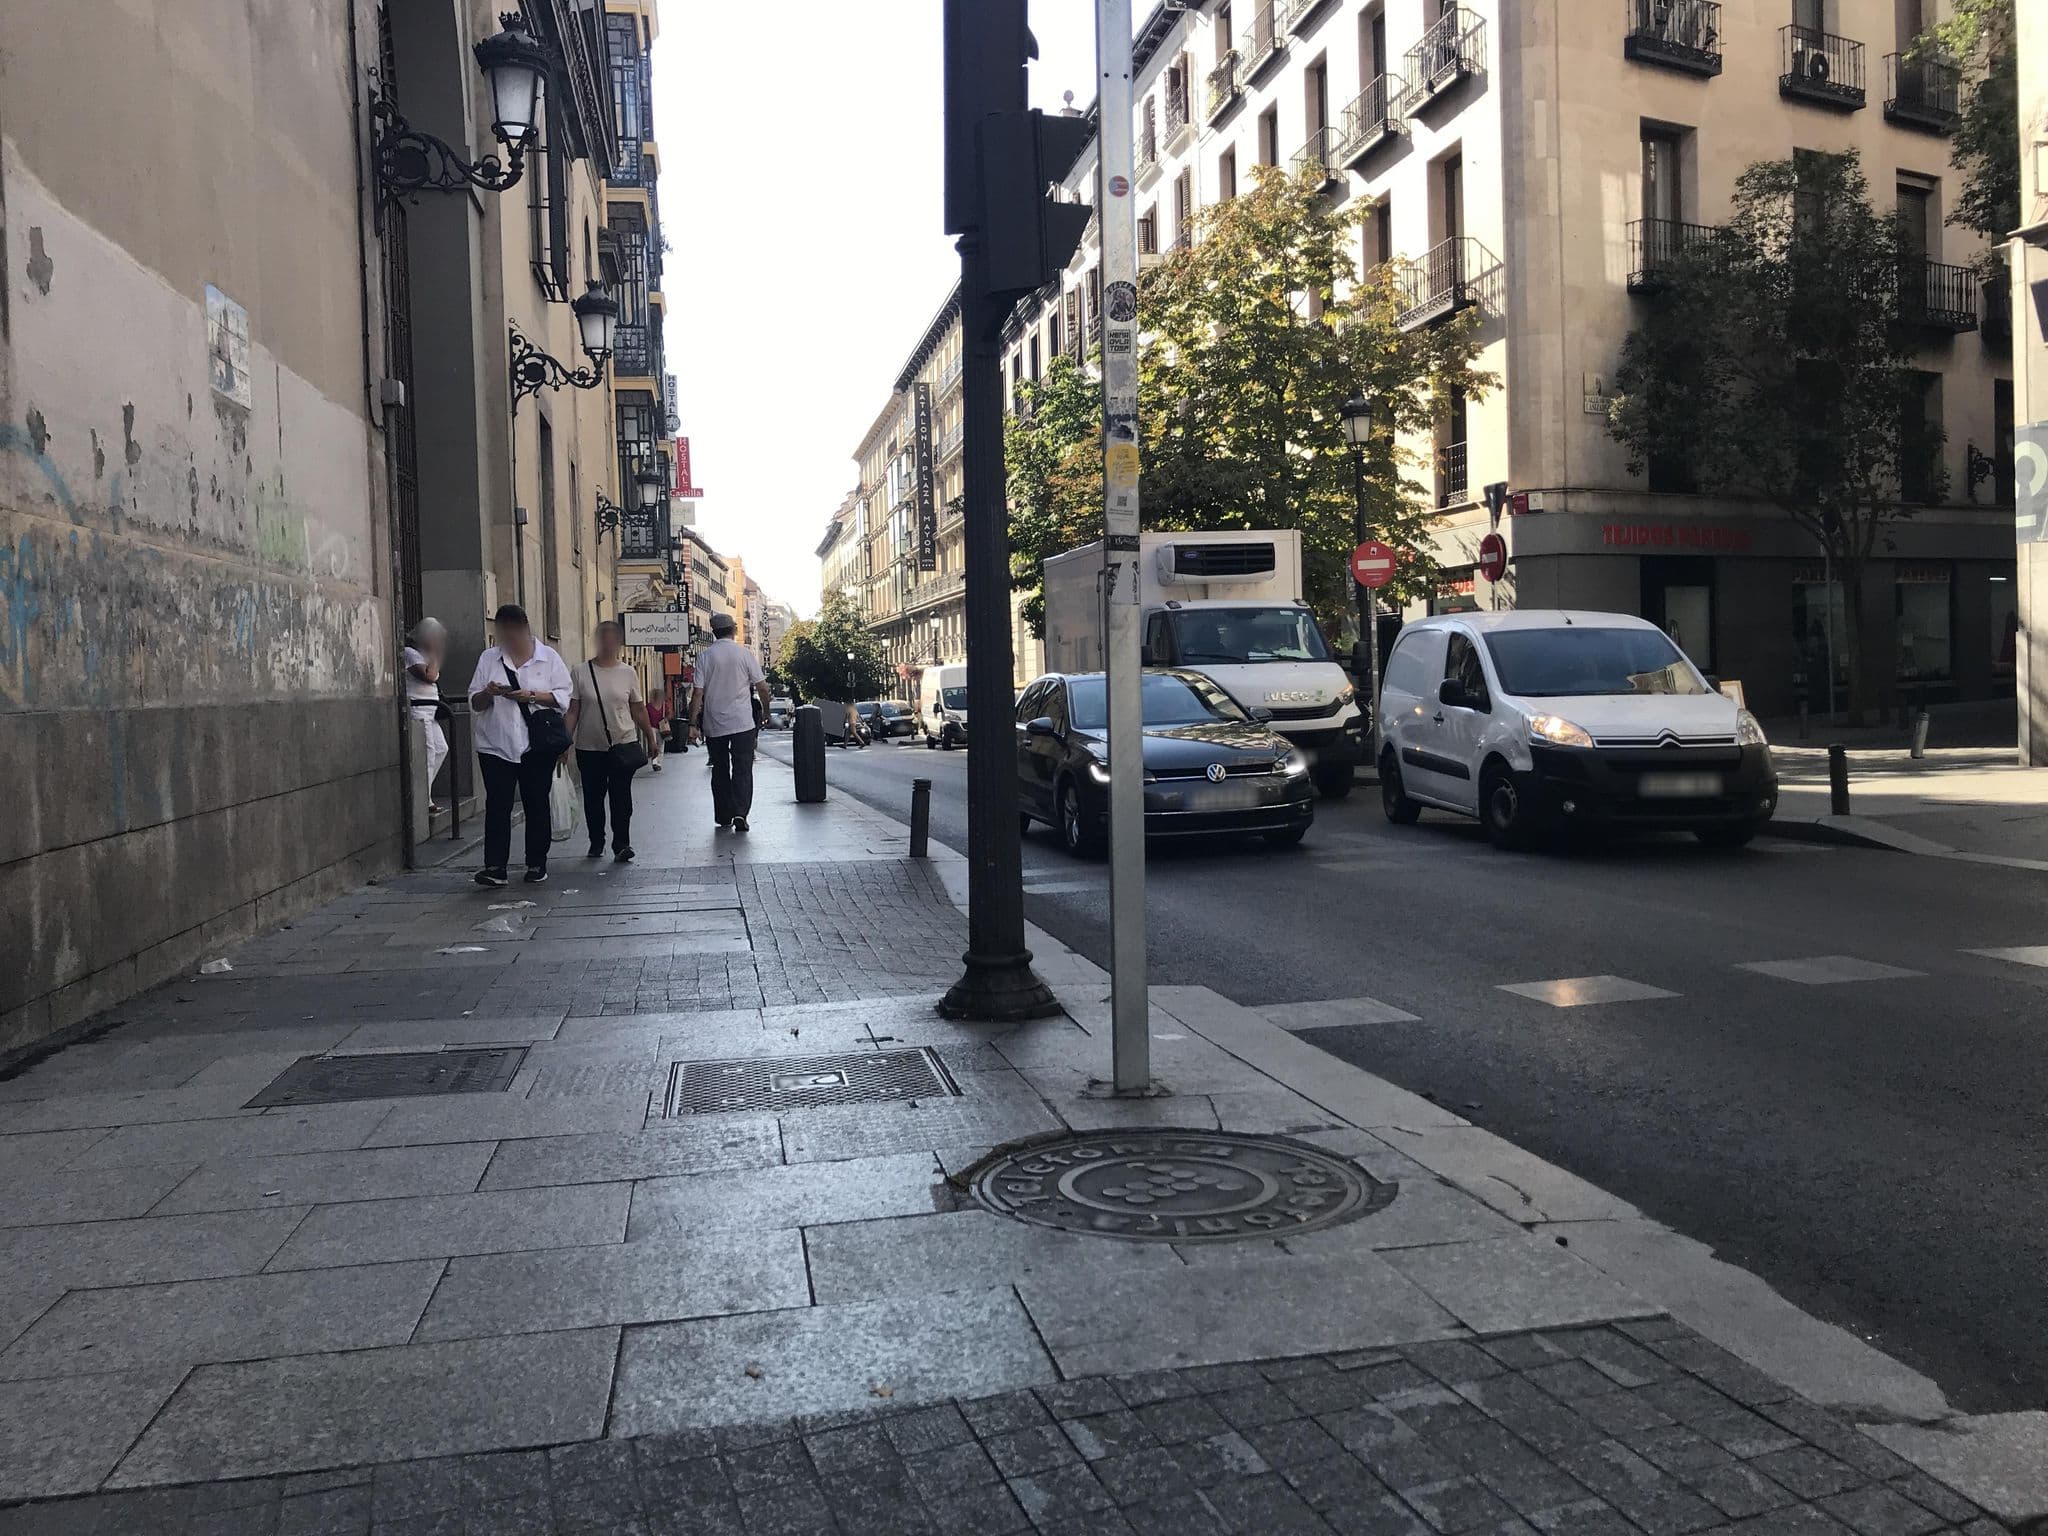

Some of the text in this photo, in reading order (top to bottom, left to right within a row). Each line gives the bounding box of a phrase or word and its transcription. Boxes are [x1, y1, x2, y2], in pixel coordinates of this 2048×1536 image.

[667, 375, 677, 414] HOSTAL
[680, 437, 689, 481] HOSTAL
[919, 385, 931, 554] CATALONIA PLAZA MAYOR
[670, 488, 702, 497] Castilla
